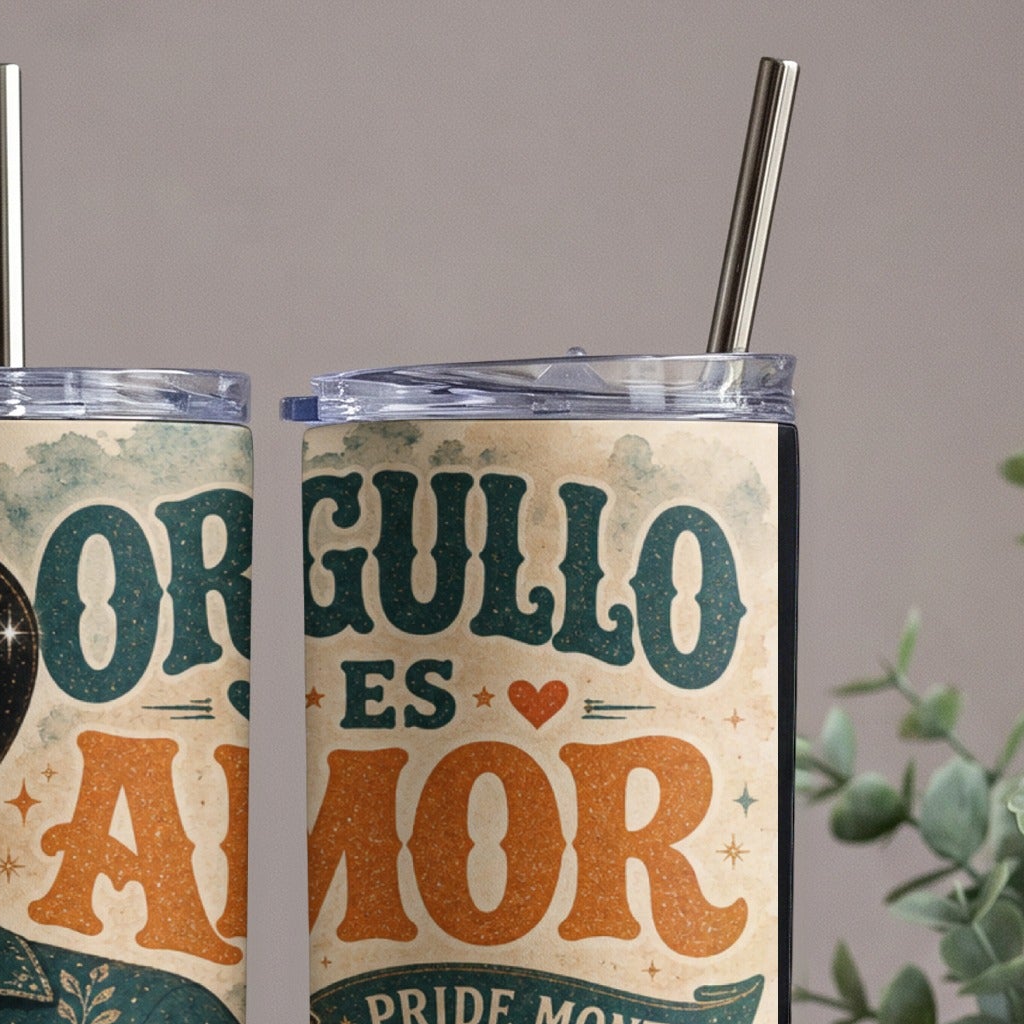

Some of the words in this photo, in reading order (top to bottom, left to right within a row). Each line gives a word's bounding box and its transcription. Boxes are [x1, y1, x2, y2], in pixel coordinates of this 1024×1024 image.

[36, 488, 253, 704] OR
[340, 660, 457, 730] ES
[28, 730, 248, 965] A
